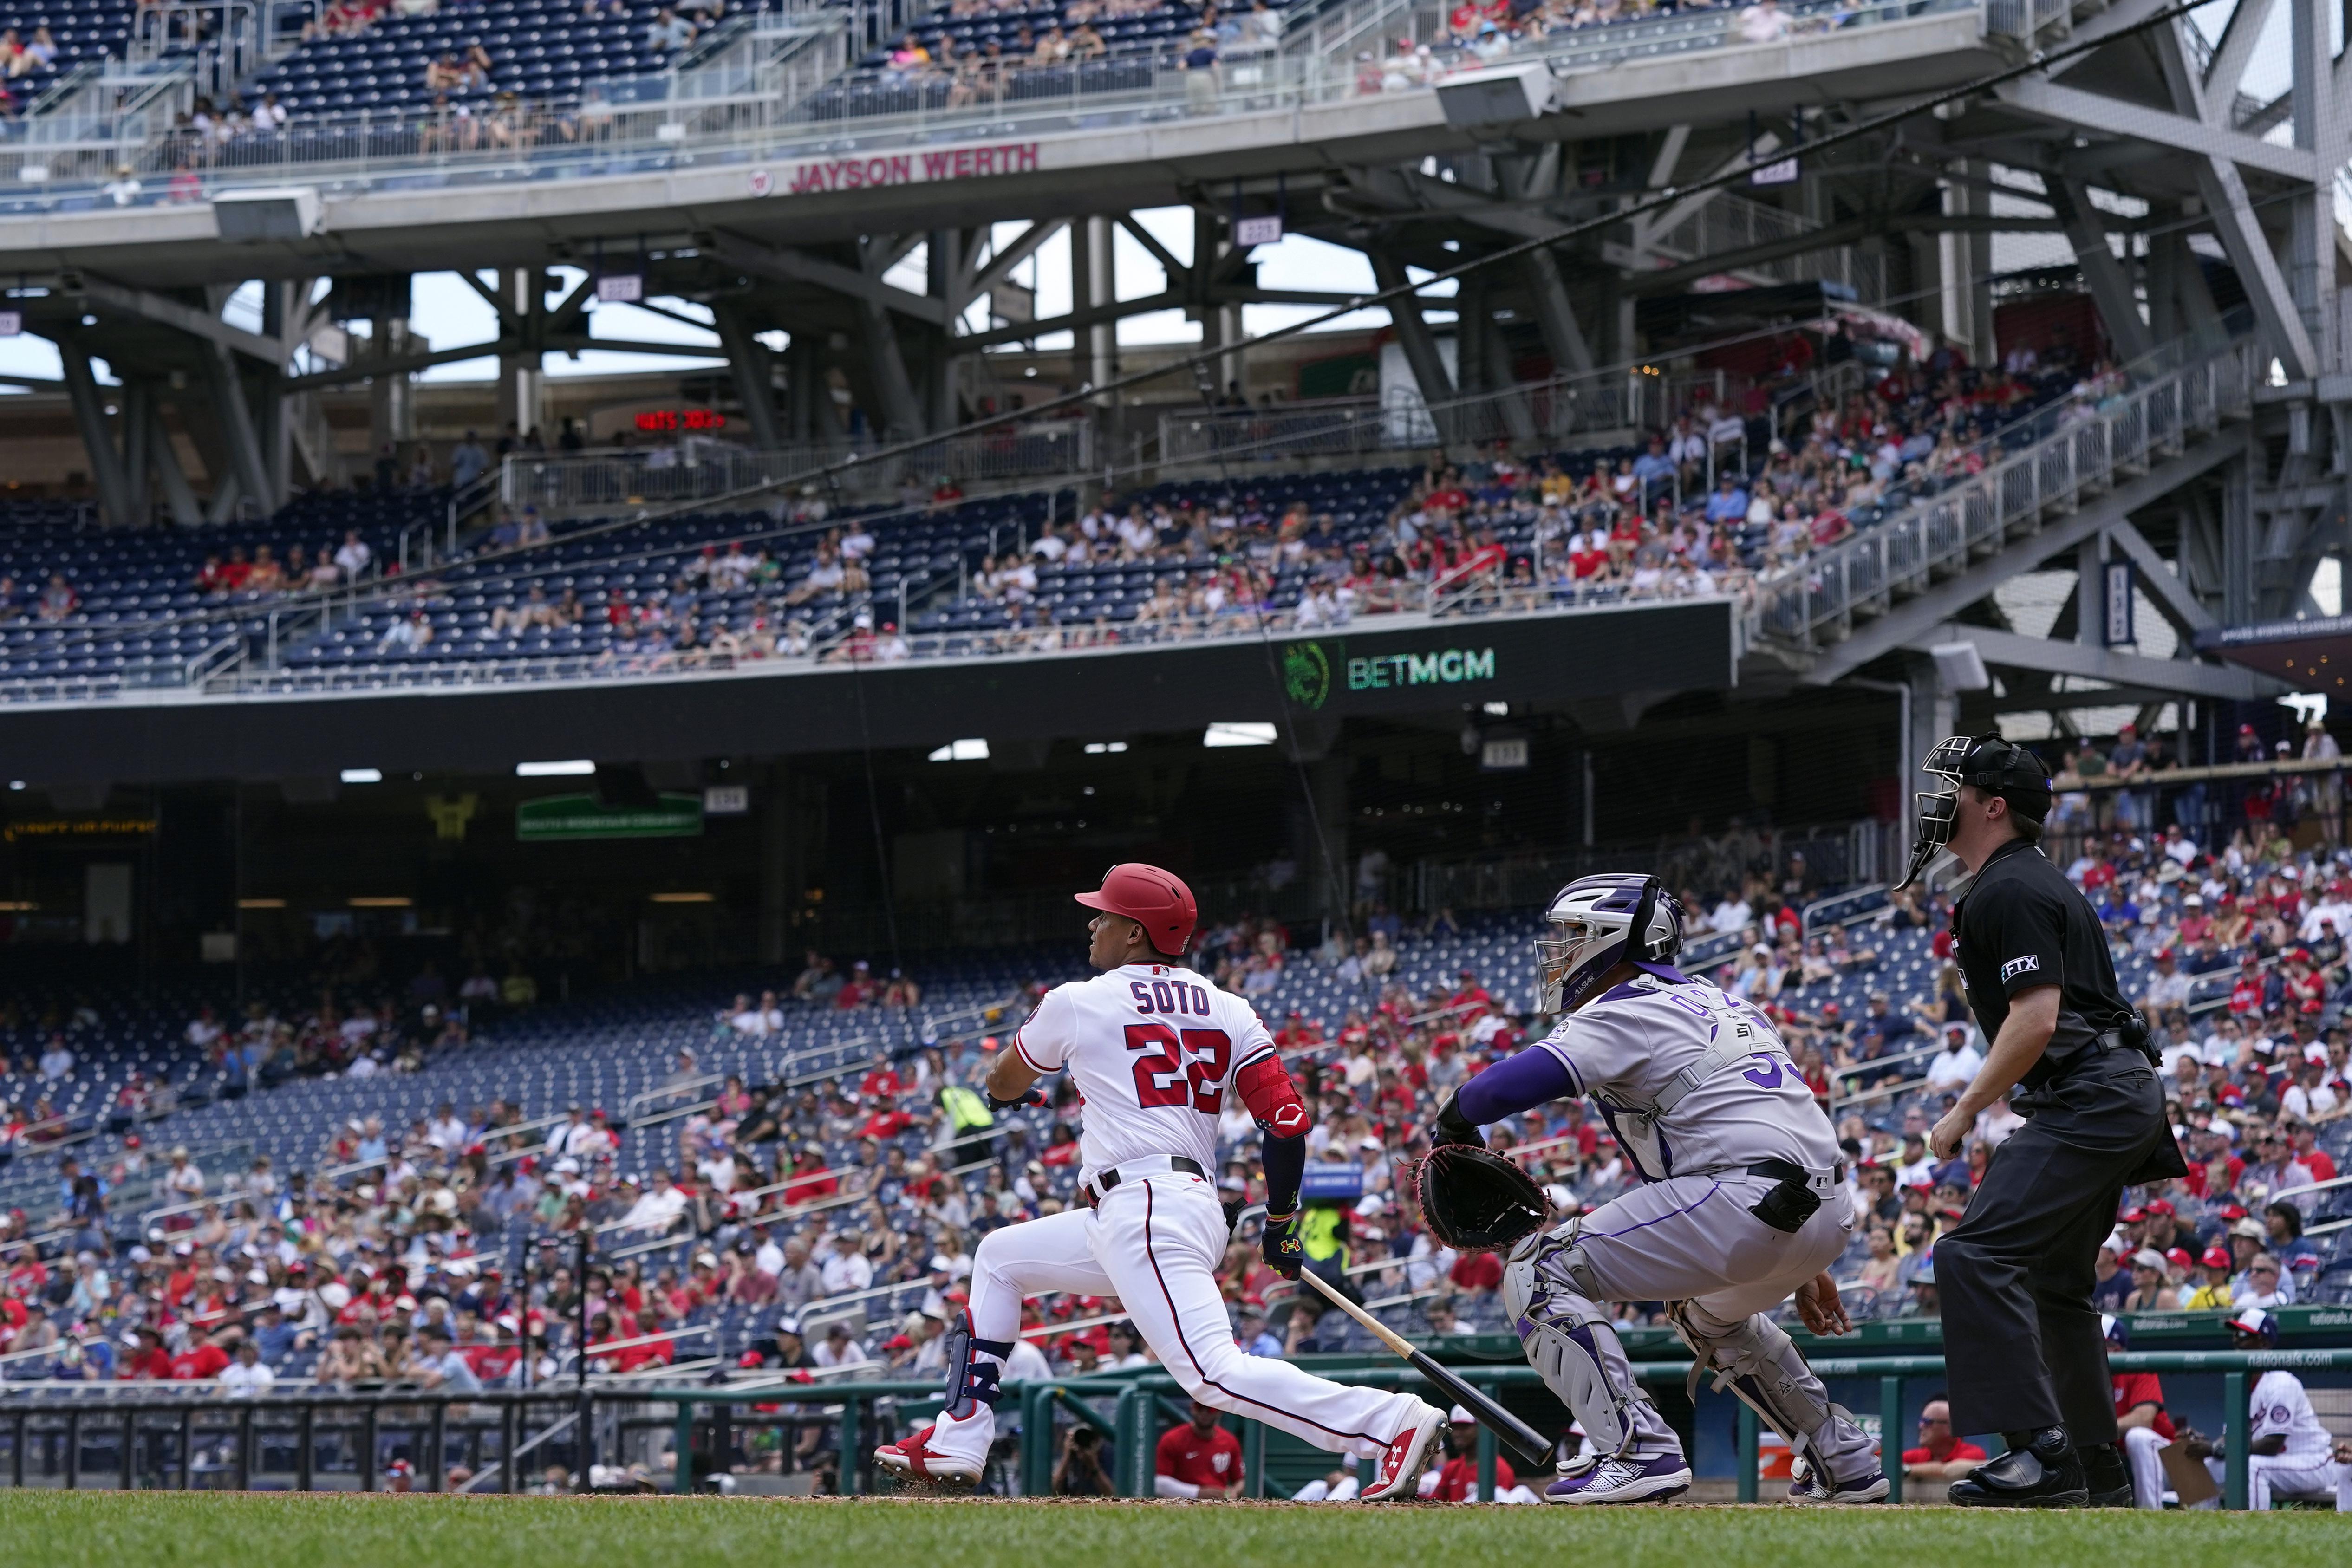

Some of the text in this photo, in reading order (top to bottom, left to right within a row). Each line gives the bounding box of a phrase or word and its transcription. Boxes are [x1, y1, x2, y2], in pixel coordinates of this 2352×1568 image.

[791, 142, 1038, 192] JAYSON WERTH
[1348, 648, 1495, 690] BETMGM
[2005, 956, 2038, 976] FTX
[1130, 980, 1210, 1016] SOTO
[1124, 1023, 1232, 1114] 22
[2247, 1351, 2333, 1367] nationals.com
